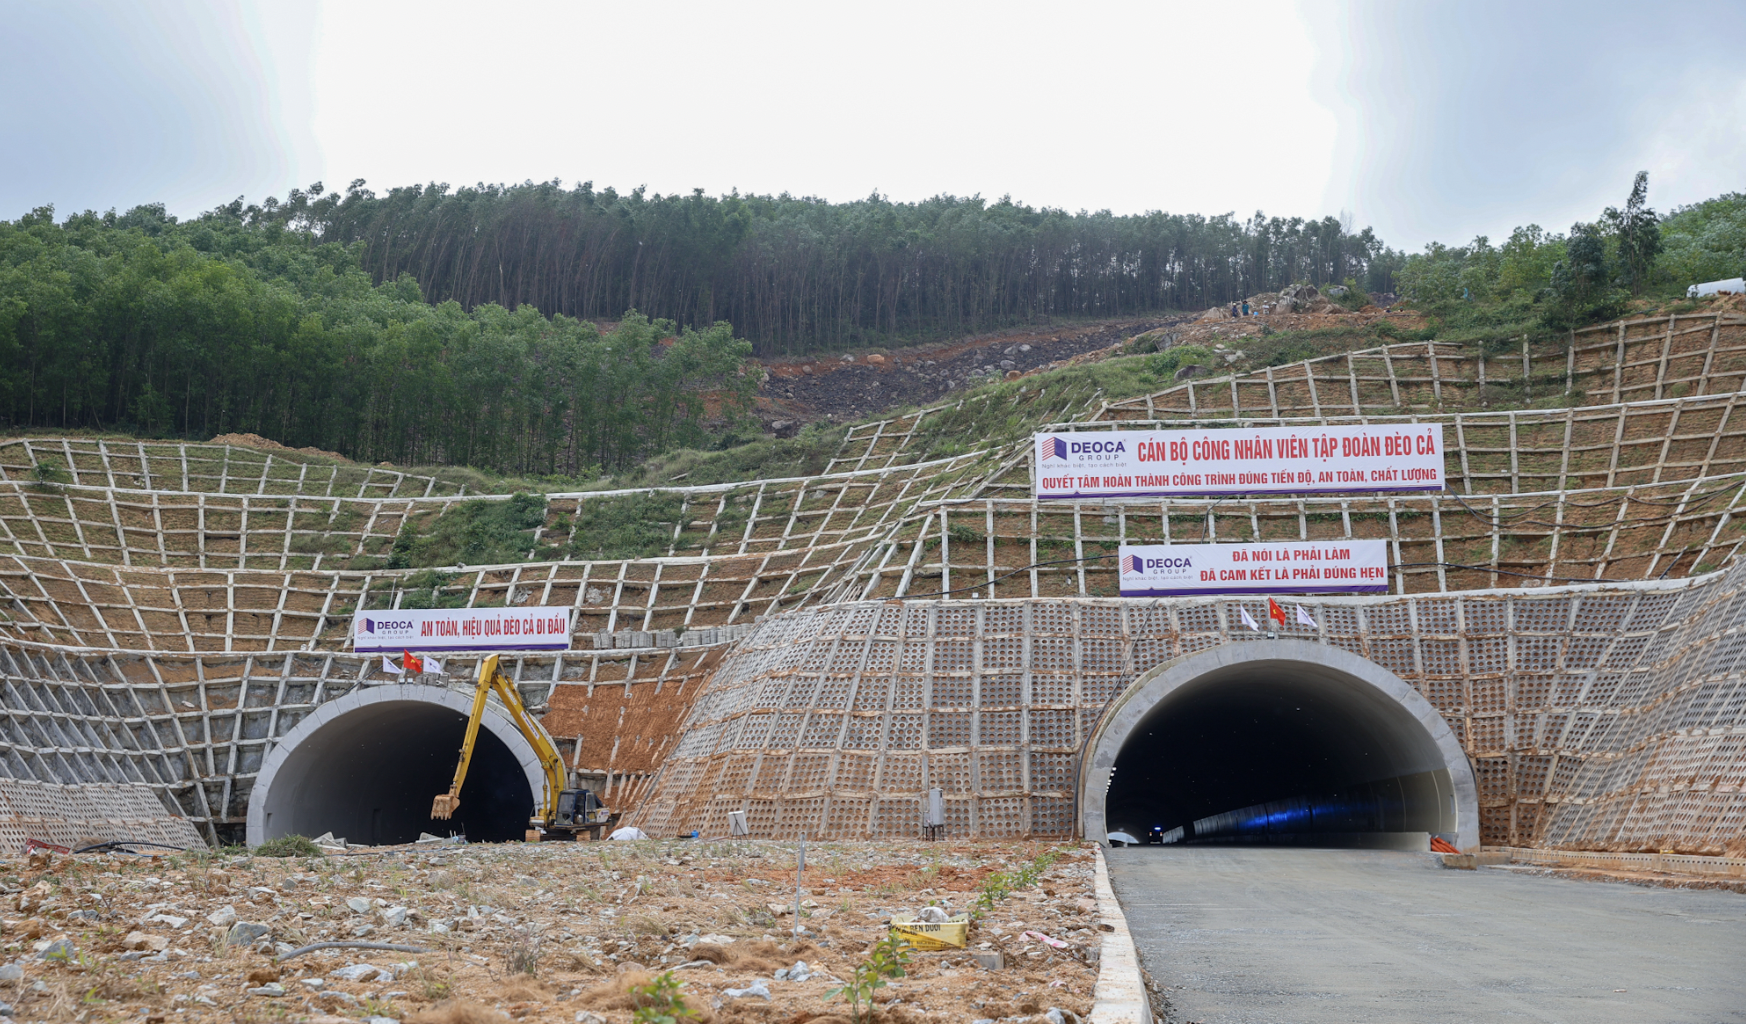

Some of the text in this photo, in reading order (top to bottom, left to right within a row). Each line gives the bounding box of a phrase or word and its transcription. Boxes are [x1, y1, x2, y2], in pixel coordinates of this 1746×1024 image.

[1071, 441, 1125, 454] DEOCA
[1138, 428, 1435, 465] CÁN BỘ CÔNG NHÂN VIÊN TẬP ĐOÀN ĐÈO CẢ
[1043, 466, 1436, 489] QUYẾT TÂM HOÀN THÀNH CÔNG TRÌNH ĐÚNG TIẾN ĐỘ, AN TOÀN, CHẤT LƯỢNG
[1232, 546, 1350, 562] ĐÃ NÓI LÀ PHẢI LÀM
[1147, 558, 1192, 568] DEOCA
[1200, 565, 1384, 581] ĐÃ CAM KẾT LÀ PHẢI ĐÚNG HẸN
[377, 621, 413, 629] DEOCA
[421, 621, 433, 636] AN
[436, 617, 460, 638] TOÀN,
[463, 617, 481, 639] HIỆU
[485, 614, 501, 637] QUẢ
[504, 616, 520, 635] ĐÈO
[523, 613, 534, 635] CẢ
[537, 619, 545, 634] ĐI
